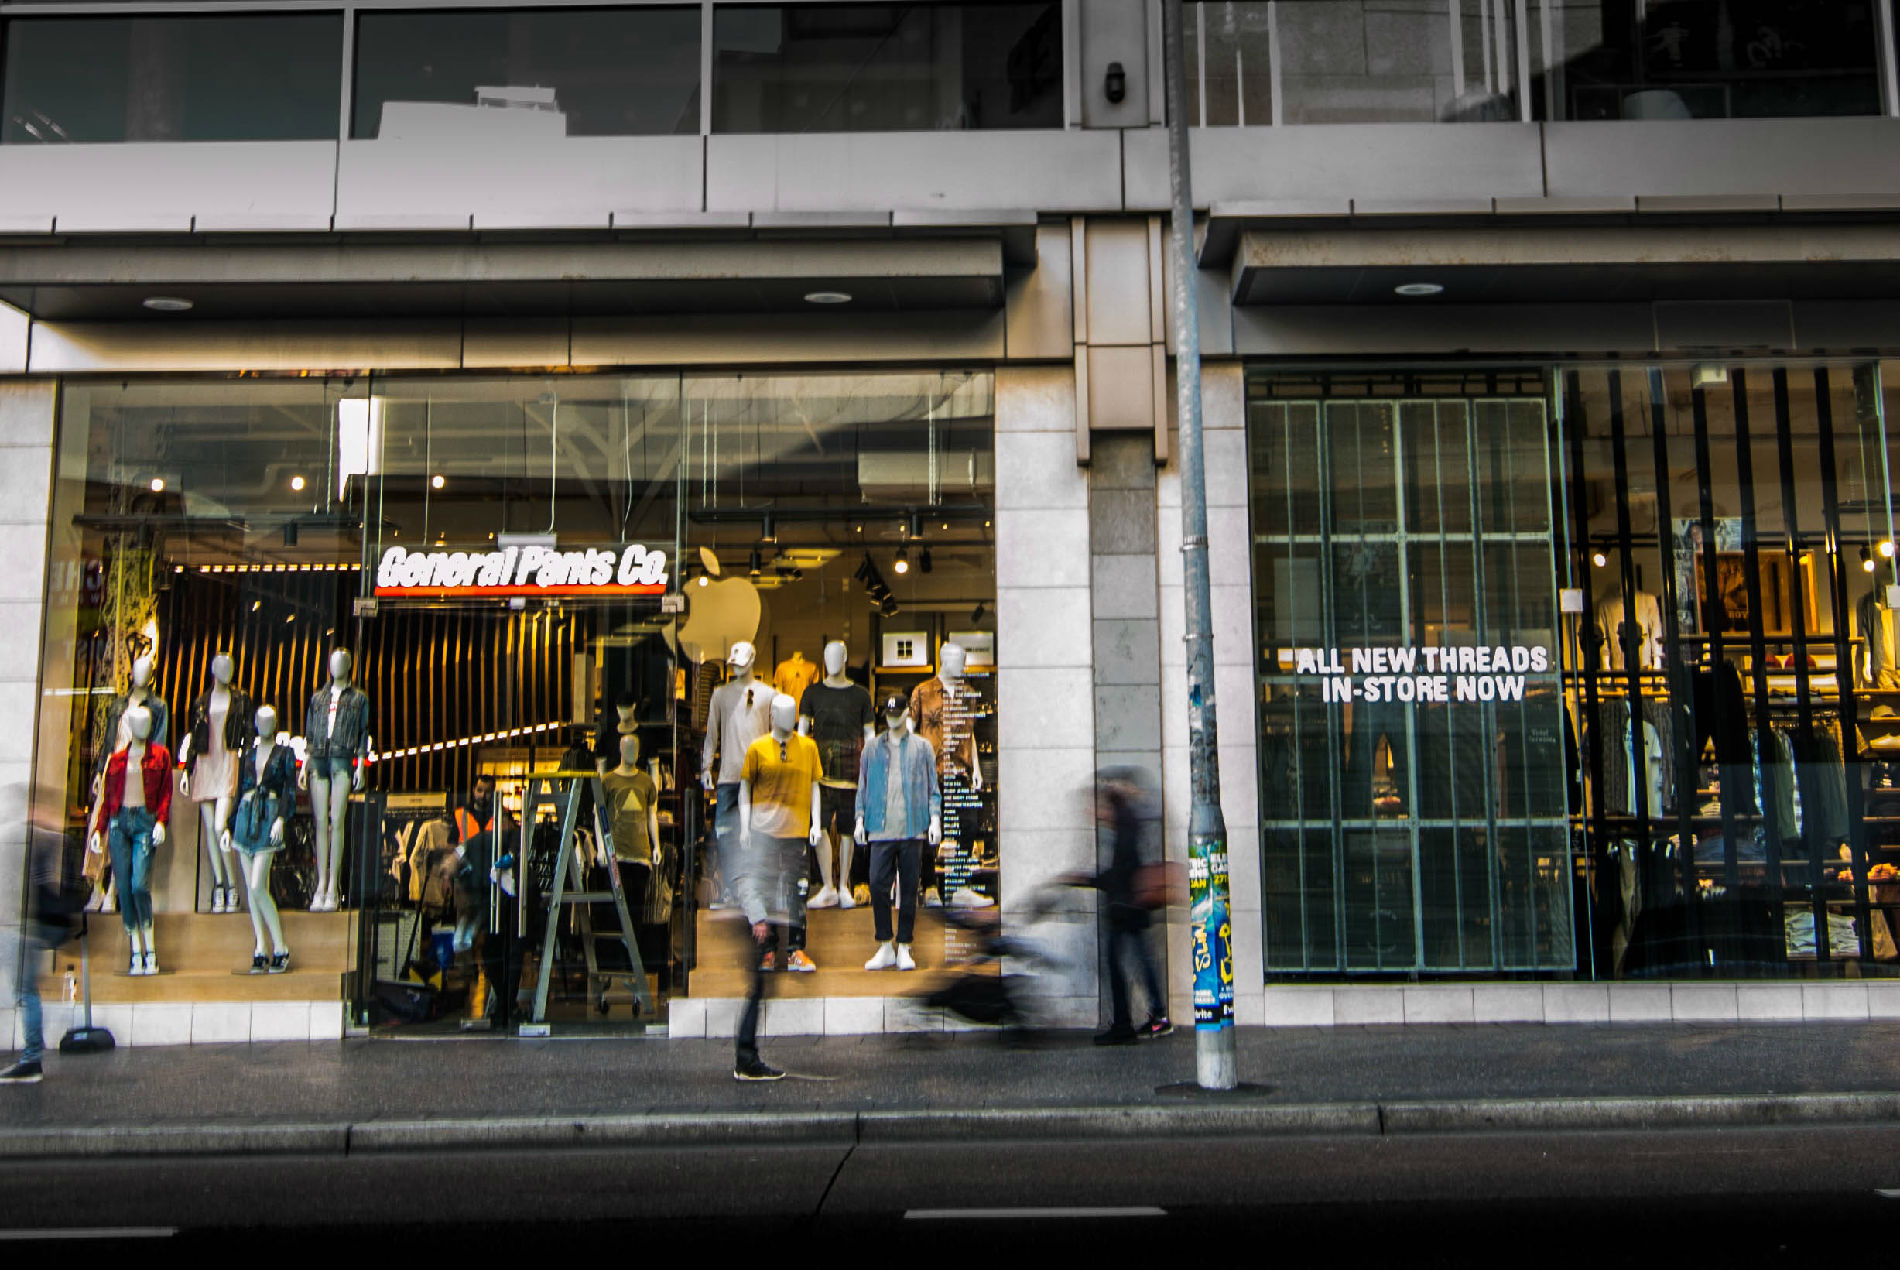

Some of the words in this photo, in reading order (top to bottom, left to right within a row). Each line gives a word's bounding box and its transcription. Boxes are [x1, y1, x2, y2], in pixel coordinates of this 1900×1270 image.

[377, 546, 518, 587] General
[516, 546, 615, 587] Pants
[617, 544, 668, 586] Co.
[1297, 648, 1344, 674] ALL
[1352, 647, 1416, 674] NEW
[1422, 646, 1548, 673] THREADS
[1323, 676, 1448, 703] IN-STORE
[1456, 675, 1525, 702] NOW
